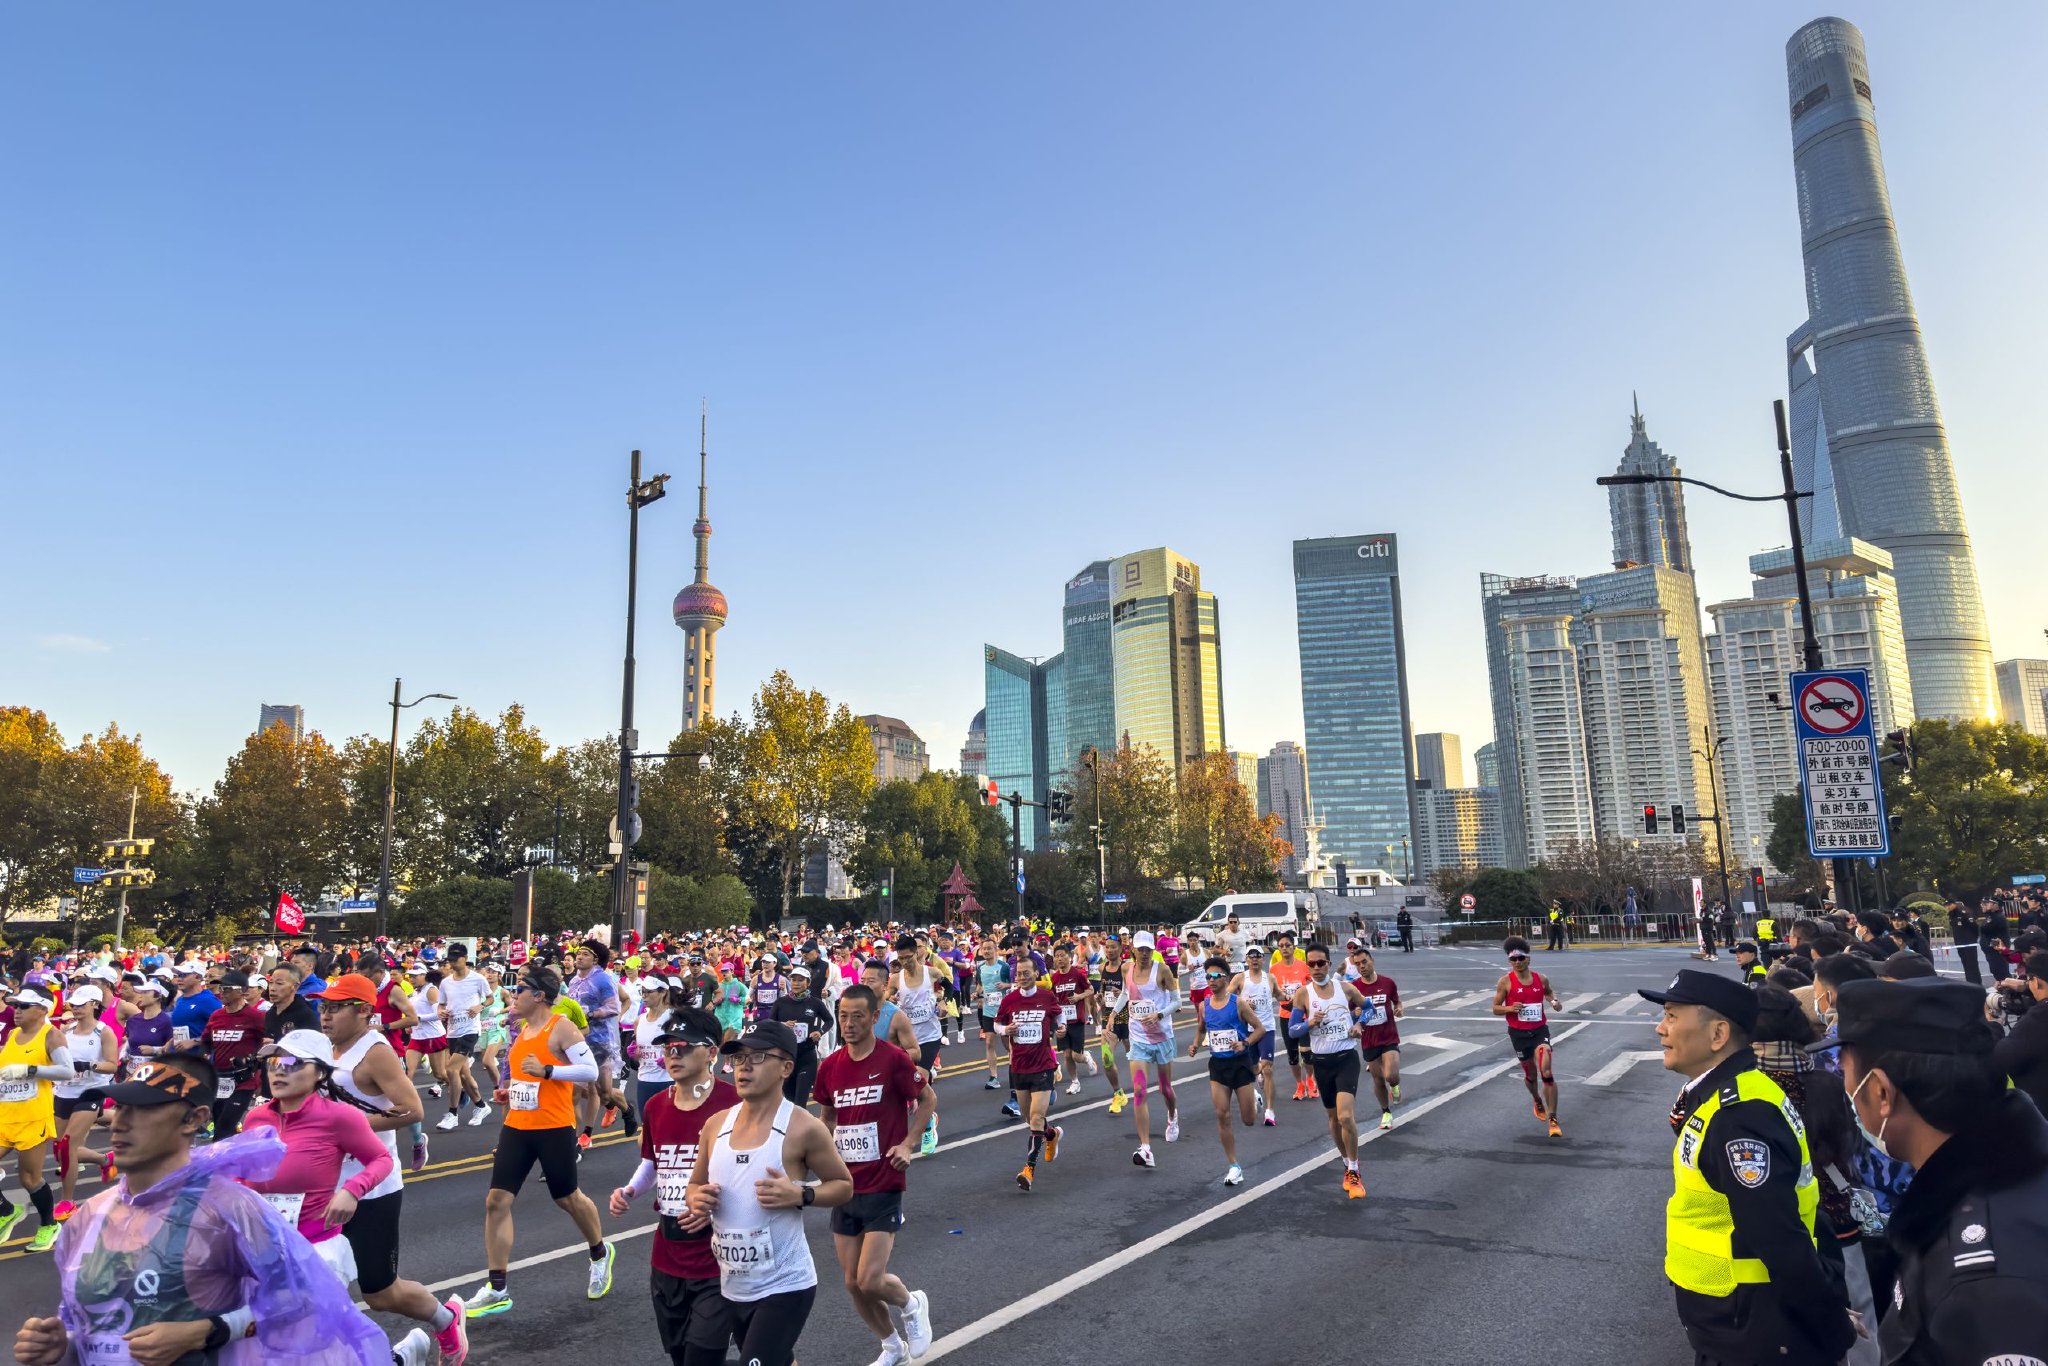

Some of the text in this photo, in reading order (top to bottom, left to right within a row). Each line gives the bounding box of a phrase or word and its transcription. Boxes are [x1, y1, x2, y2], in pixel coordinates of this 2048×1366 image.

[1357, 540, 1389, 558] citi
[1808, 741, 1866, 753] 7:00-20:00
[1808, 754, 1870, 770] 外省市号牌
[1816, 770, 1866, 785] 出租空车
[1824, 786, 1861, 800] 实习车
[1820, 802, 1870, 816] 临时号牌
[1817, 833, 1880, 847] 延安东路隧道
